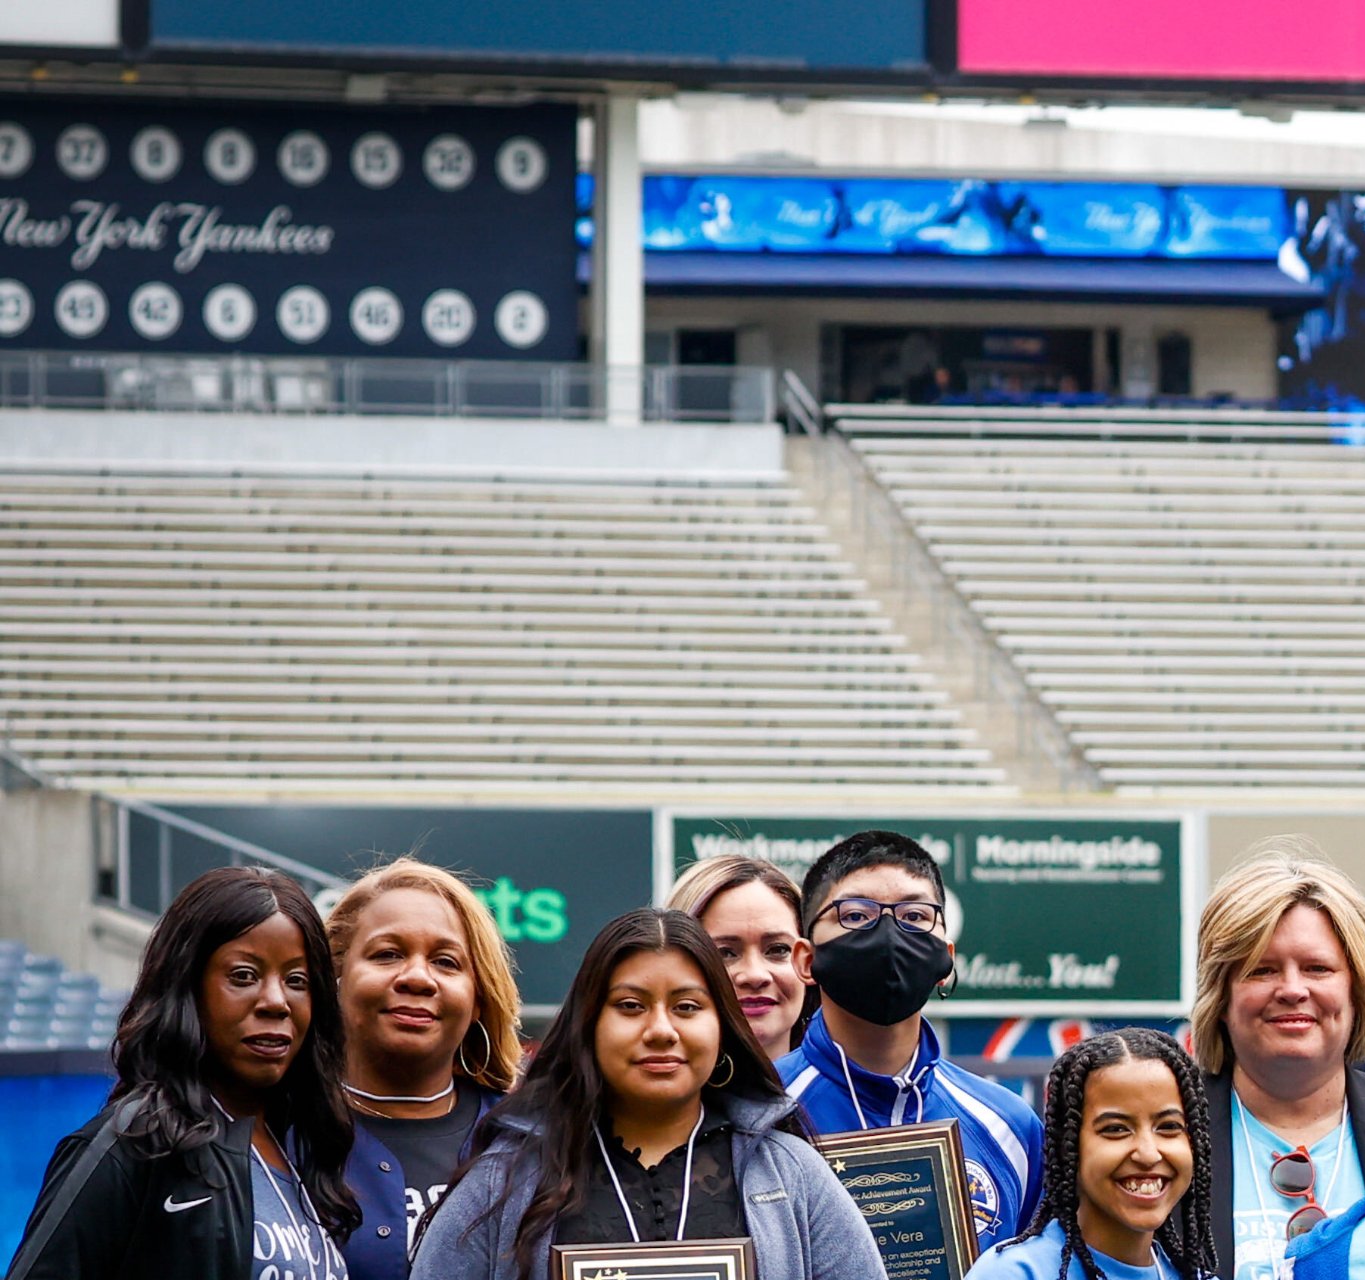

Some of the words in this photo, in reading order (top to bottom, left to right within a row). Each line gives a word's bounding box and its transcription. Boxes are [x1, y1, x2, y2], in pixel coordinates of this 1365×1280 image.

[0, 199, 70, 247] New
[70, 200, 174, 271] York
[173, 202, 336, 274] Yankees
[977, 834, 1162, 869] Morningside
[1048, 955, 1119, 988] You!
[860, 1187, 908, 1200] Achievement
[908, 1184, 932, 1194] Award
[889, 1230, 924, 1244] Vera
